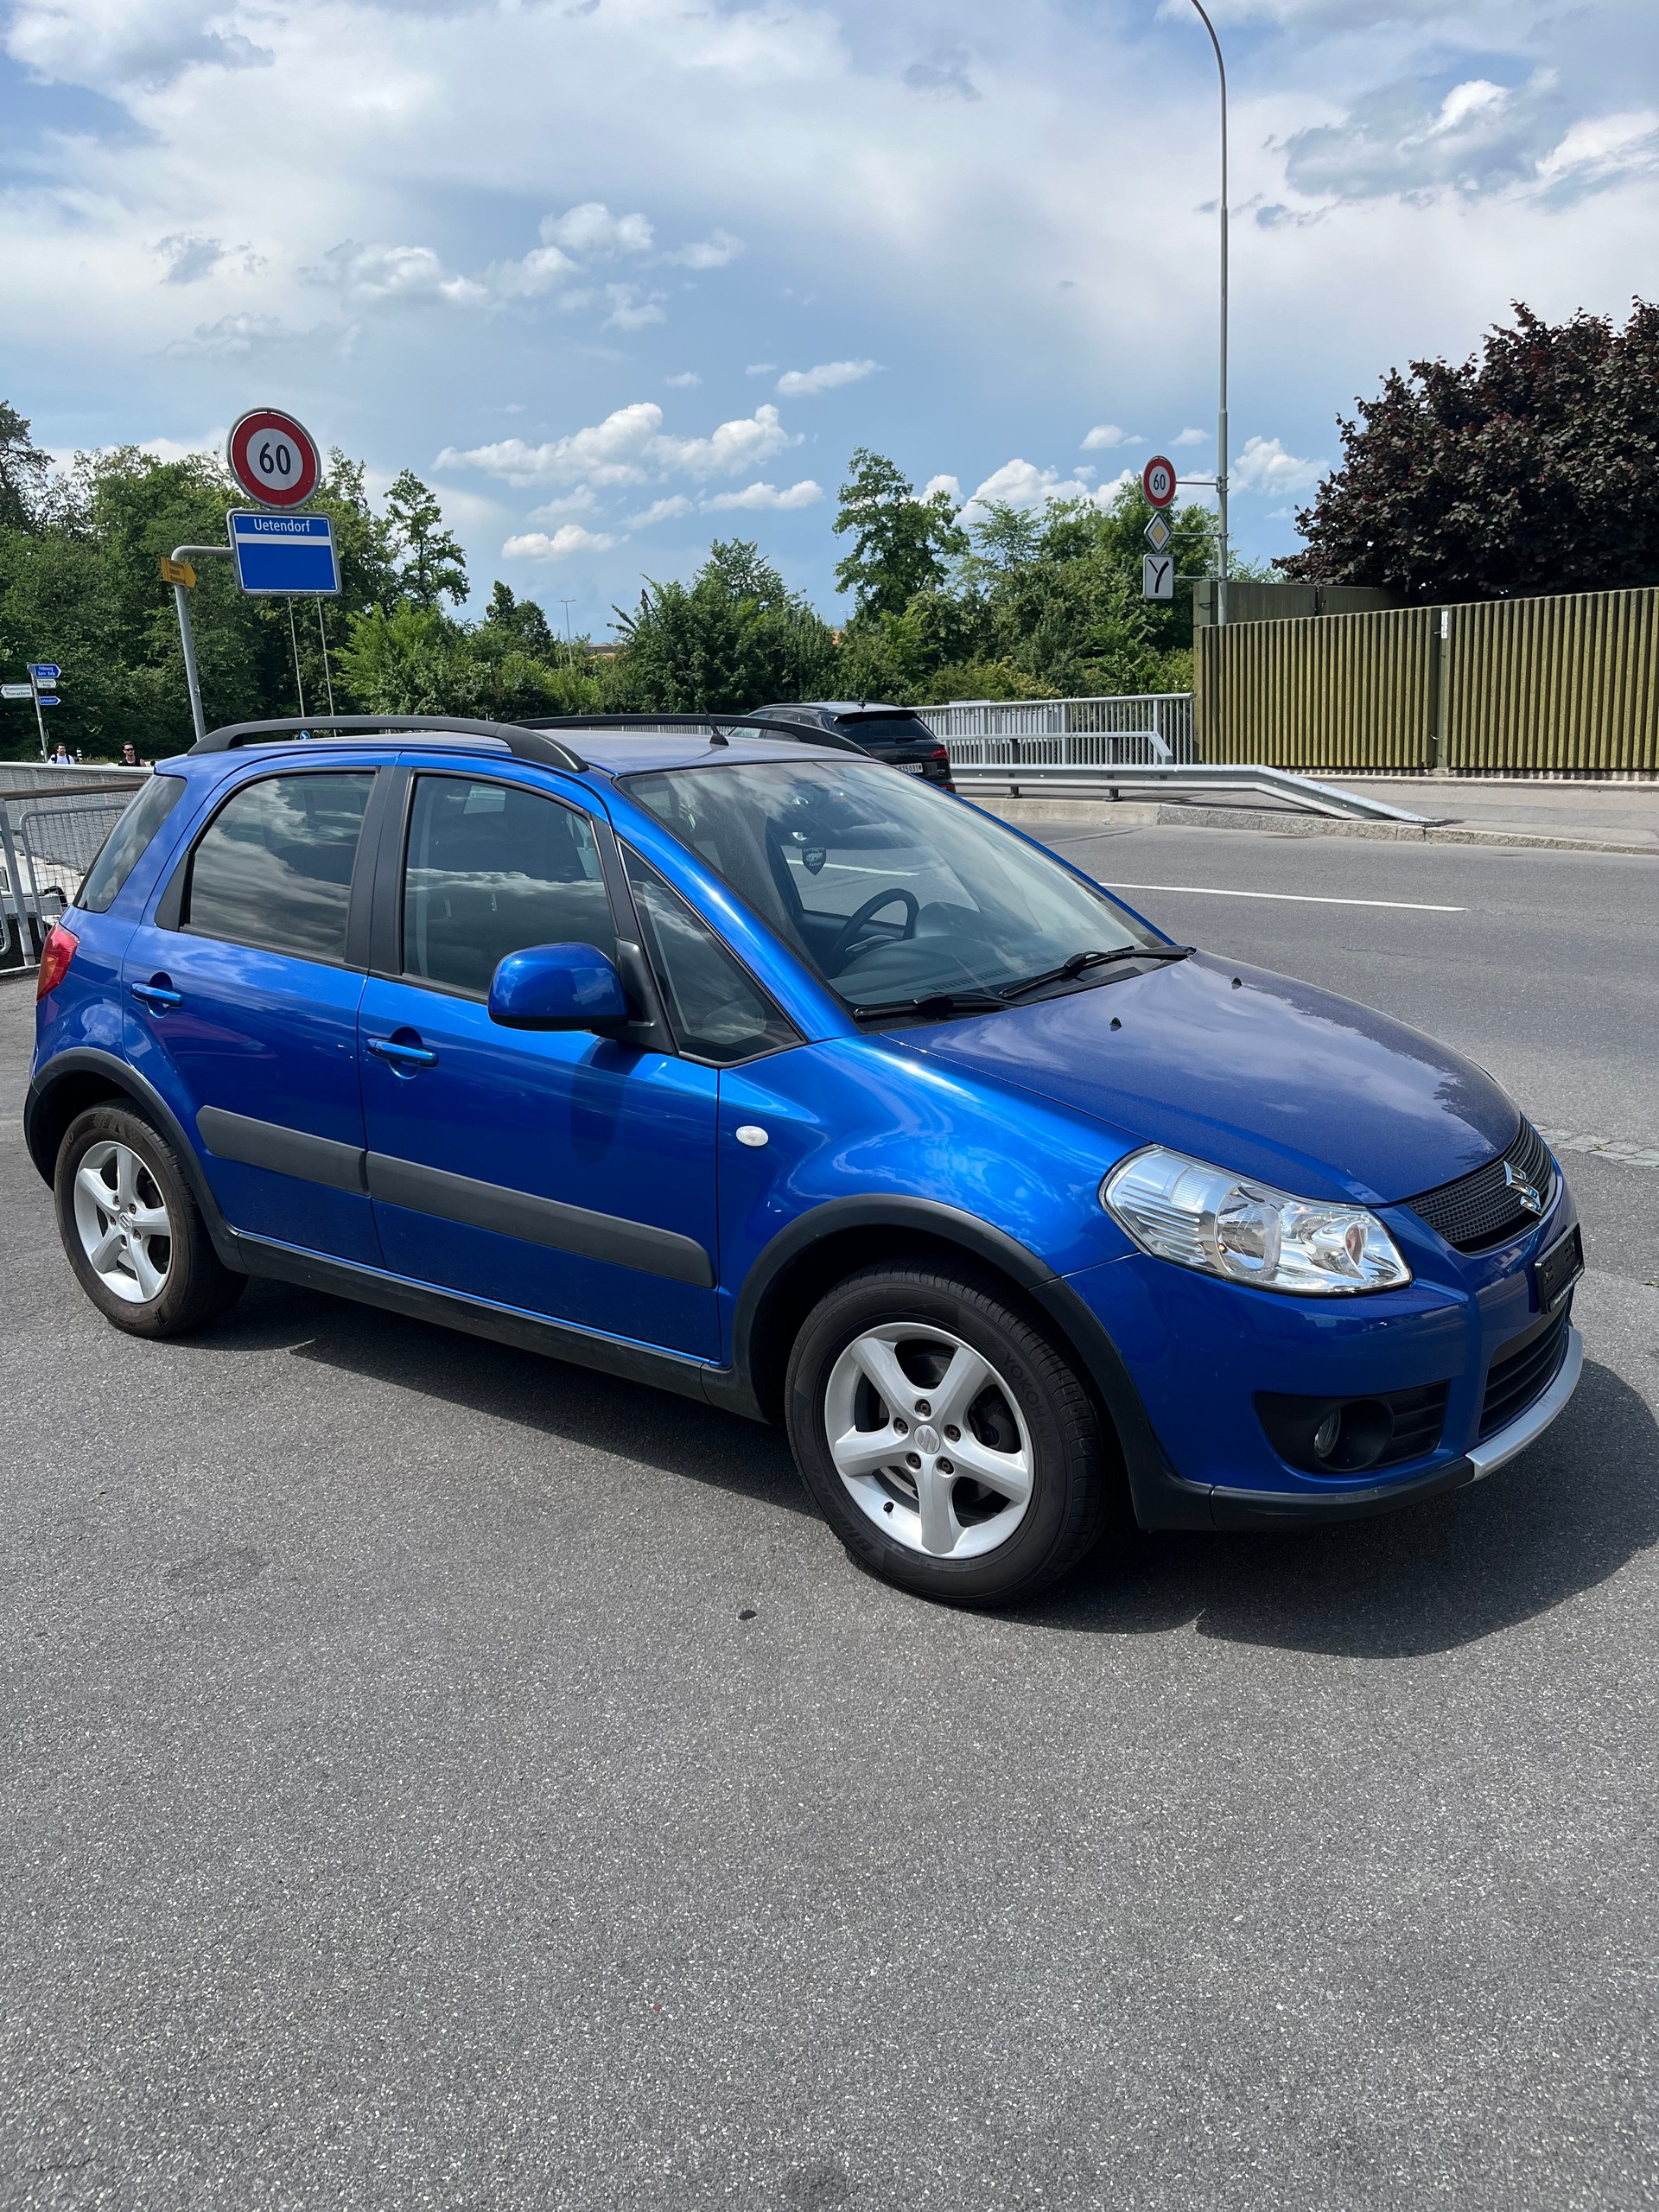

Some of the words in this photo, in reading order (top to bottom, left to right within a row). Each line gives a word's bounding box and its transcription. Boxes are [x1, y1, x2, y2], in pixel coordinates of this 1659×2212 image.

[259, 442, 290, 475] 60
[1154, 474, 1166, 490] 60
[254, 518, 310, 532] Uetendorf
[1003, 1352, 1058, 1466] YOKOHAMA
